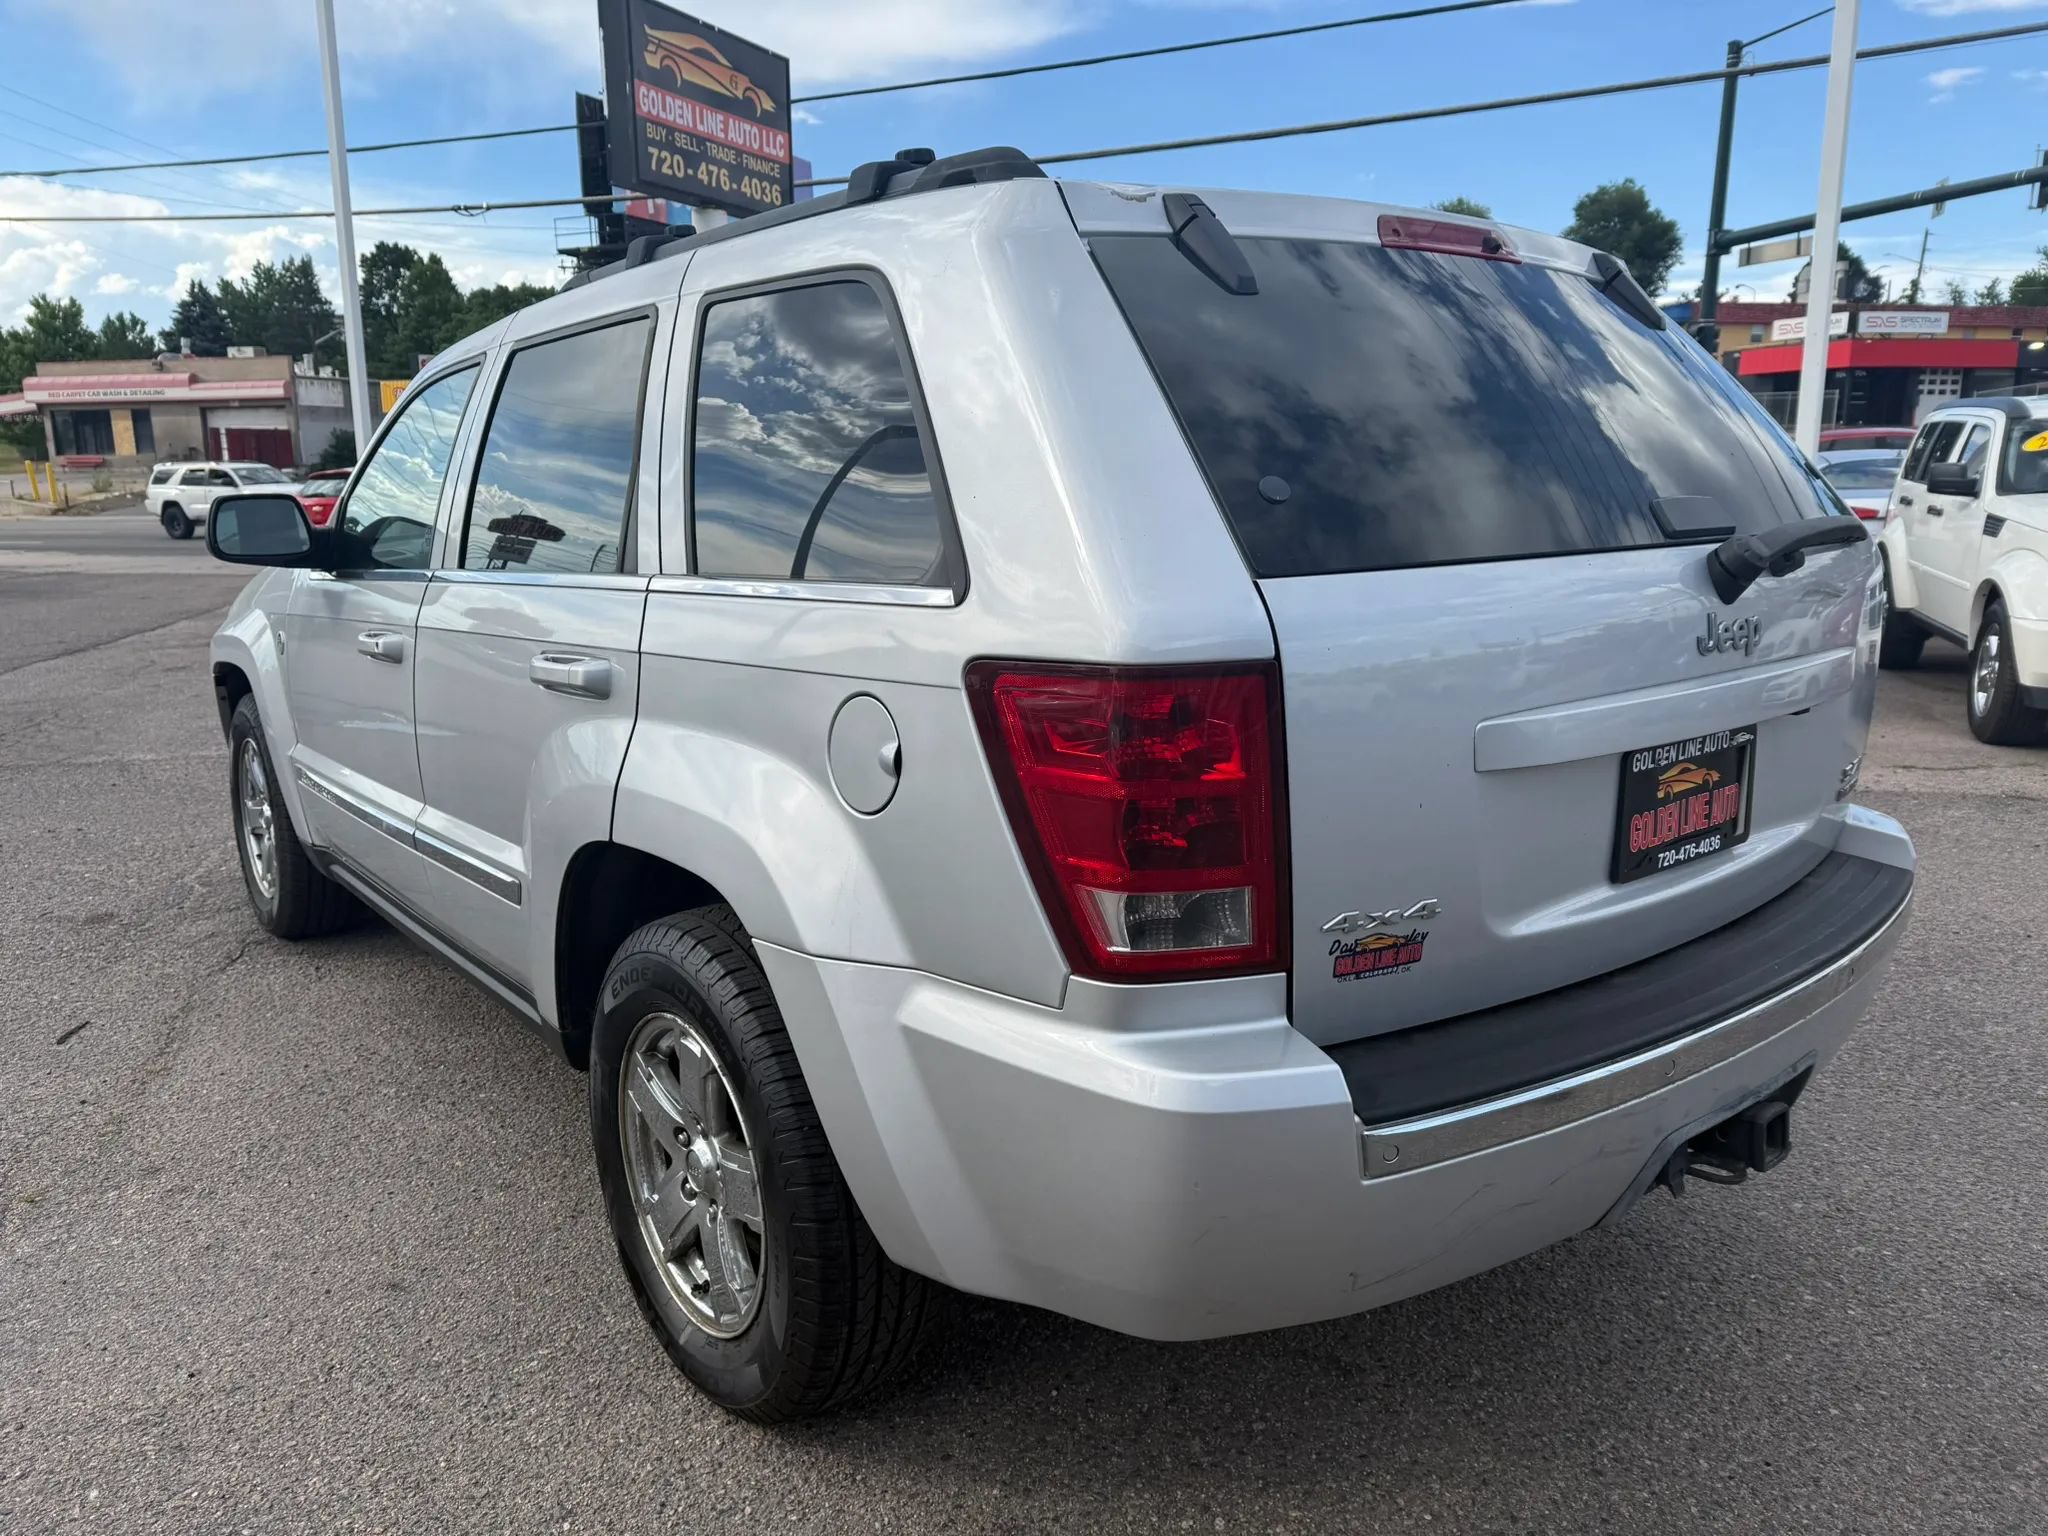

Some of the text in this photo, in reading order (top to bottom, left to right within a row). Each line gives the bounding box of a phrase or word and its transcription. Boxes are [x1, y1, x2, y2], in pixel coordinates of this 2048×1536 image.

[639, 86, 785, 158] GOLDEN LINE AUTO LLC
[646, 122, 781, 178] BUY SELL TRADE FINANCE
[129, 388, 165, 396] DETAILING
[1696, 611, 1762, 657] Jeep
[1679, 737, 1702, 760] LINE
[1703, 731, 1730, 755] AUTO
[1630, 782, 1739, 853] GOLDEN LINE AUTO
[1657, 835, 1721, 868] 720-476-4036
